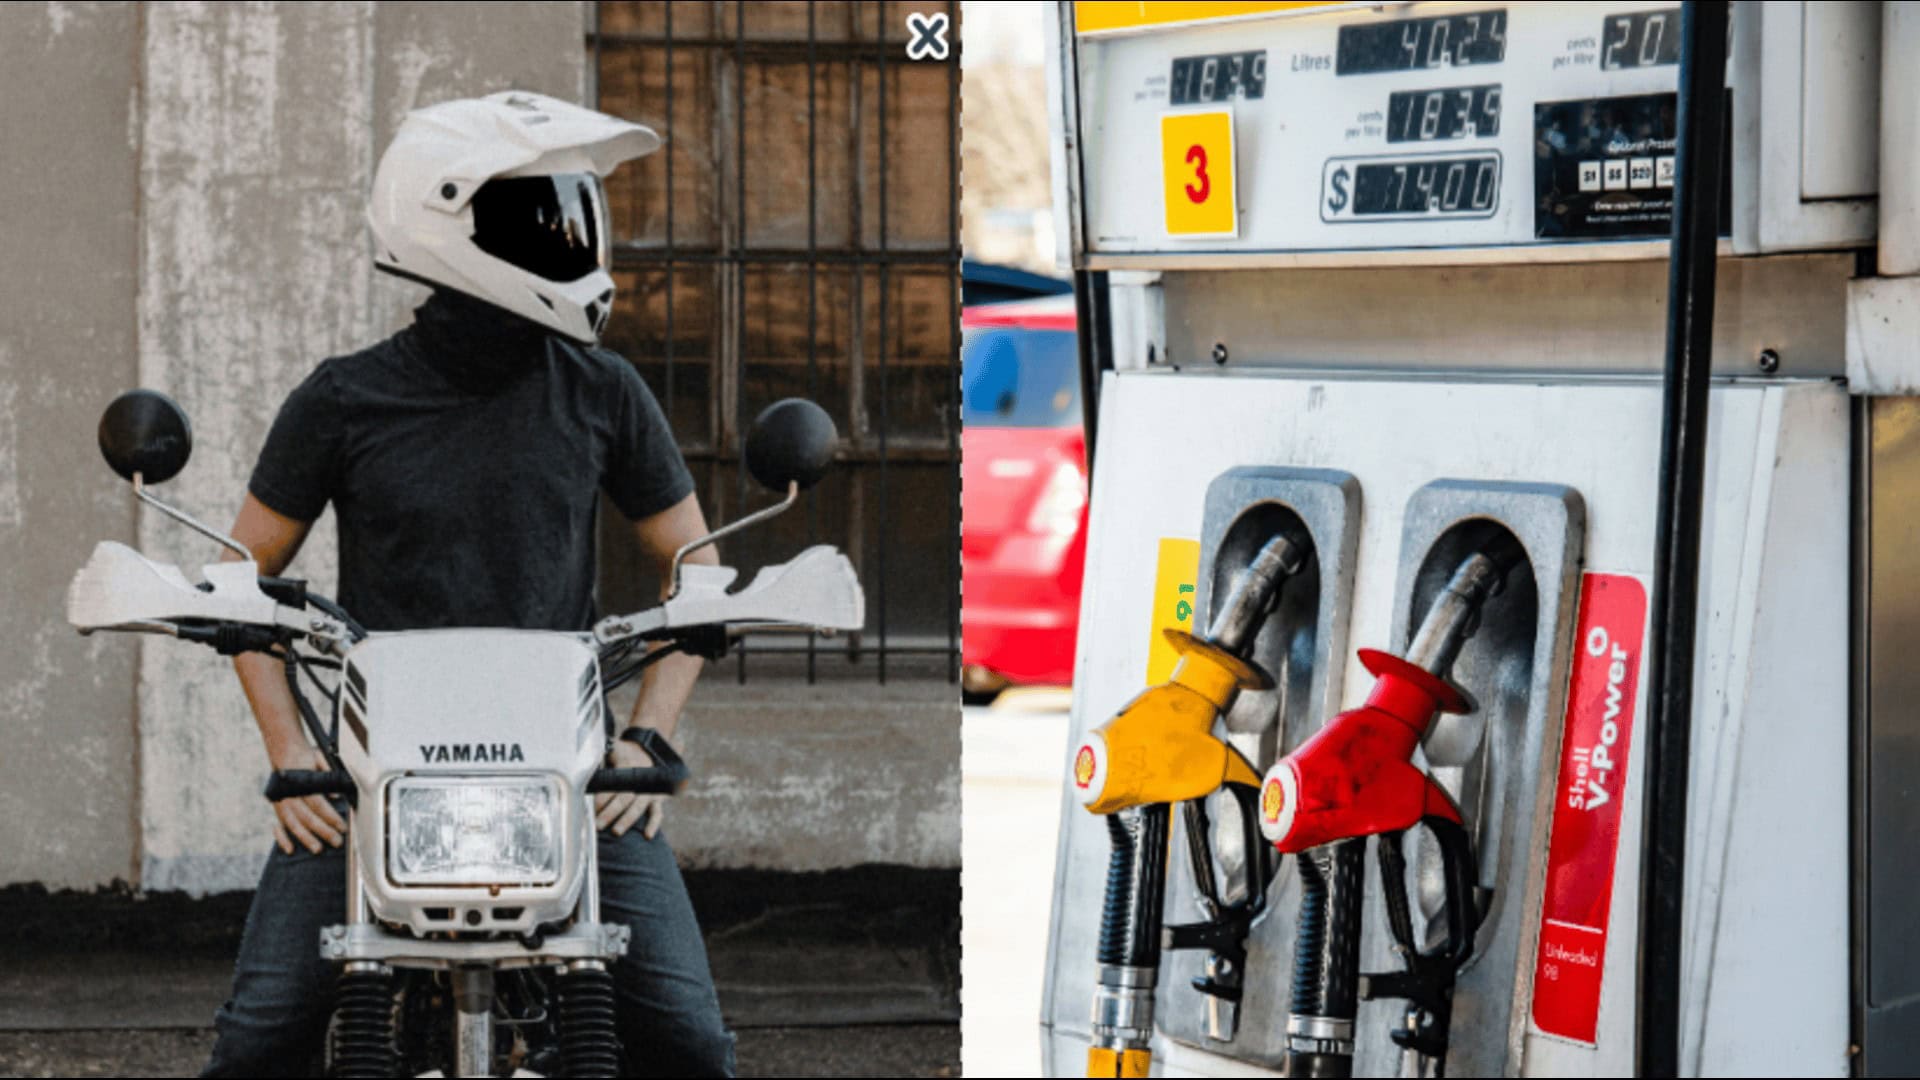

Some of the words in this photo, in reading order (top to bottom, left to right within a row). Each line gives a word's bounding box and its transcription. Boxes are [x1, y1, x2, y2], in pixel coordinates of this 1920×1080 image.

[1291, 54, 1331, 73] Litres
[1403, 87, 1501, 141] 183.9
[1184, 143, 1211, 205] 3
[1328, 165, 1350, 215] $
[1176, 584, 1195, 622] 91
[1585, 642, 1627, 811] V-Power
[419, 743, 525, 763] YAMAHA
[1568, 747, 1590, 811] Shell
[1543, 962, 1559, 981] 98
[1545, 941, 1599, 968] Unleaded
